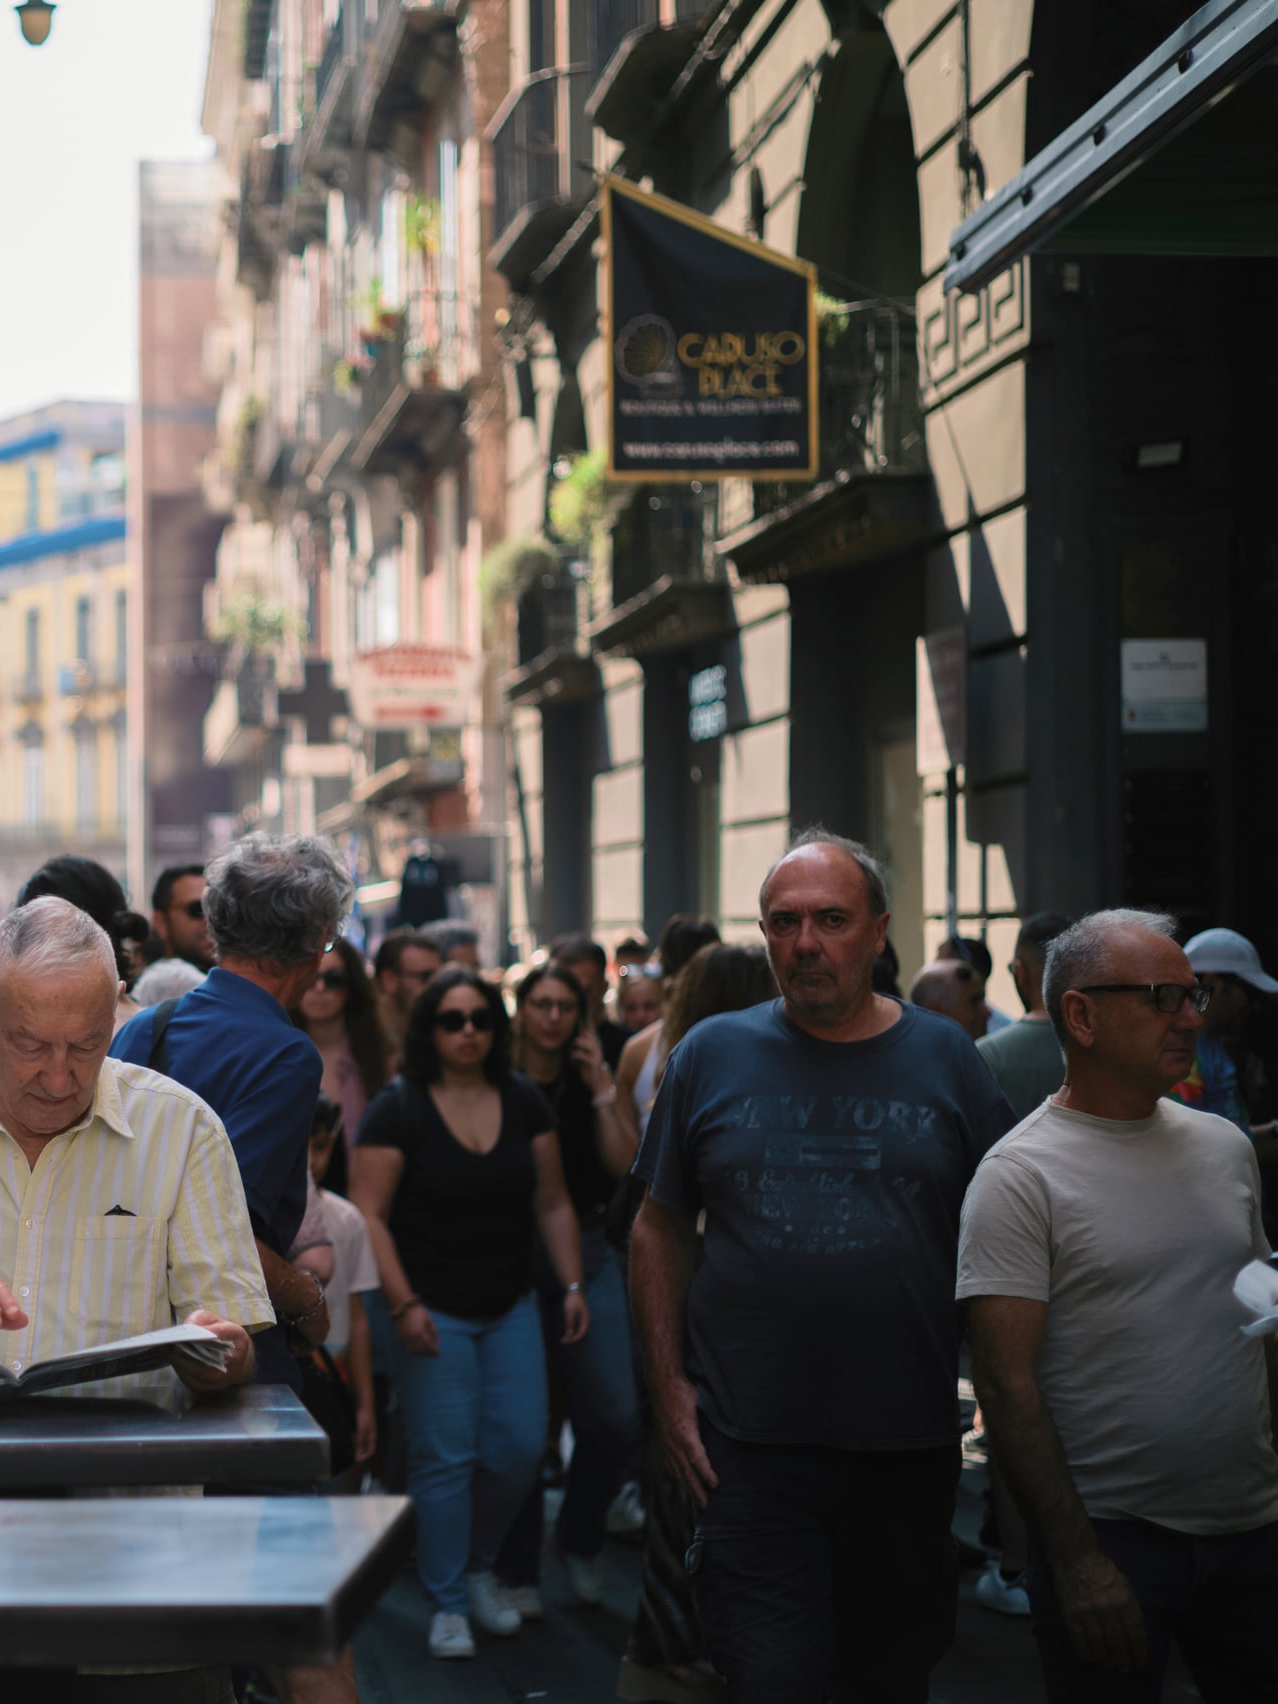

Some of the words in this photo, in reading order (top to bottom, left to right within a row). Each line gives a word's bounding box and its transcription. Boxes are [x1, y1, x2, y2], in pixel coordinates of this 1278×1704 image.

[677, 331, 805, 369] CARUSO
[699, 365, 783, 398] PLACE
[831, 1095, 939, 1144] YORK
